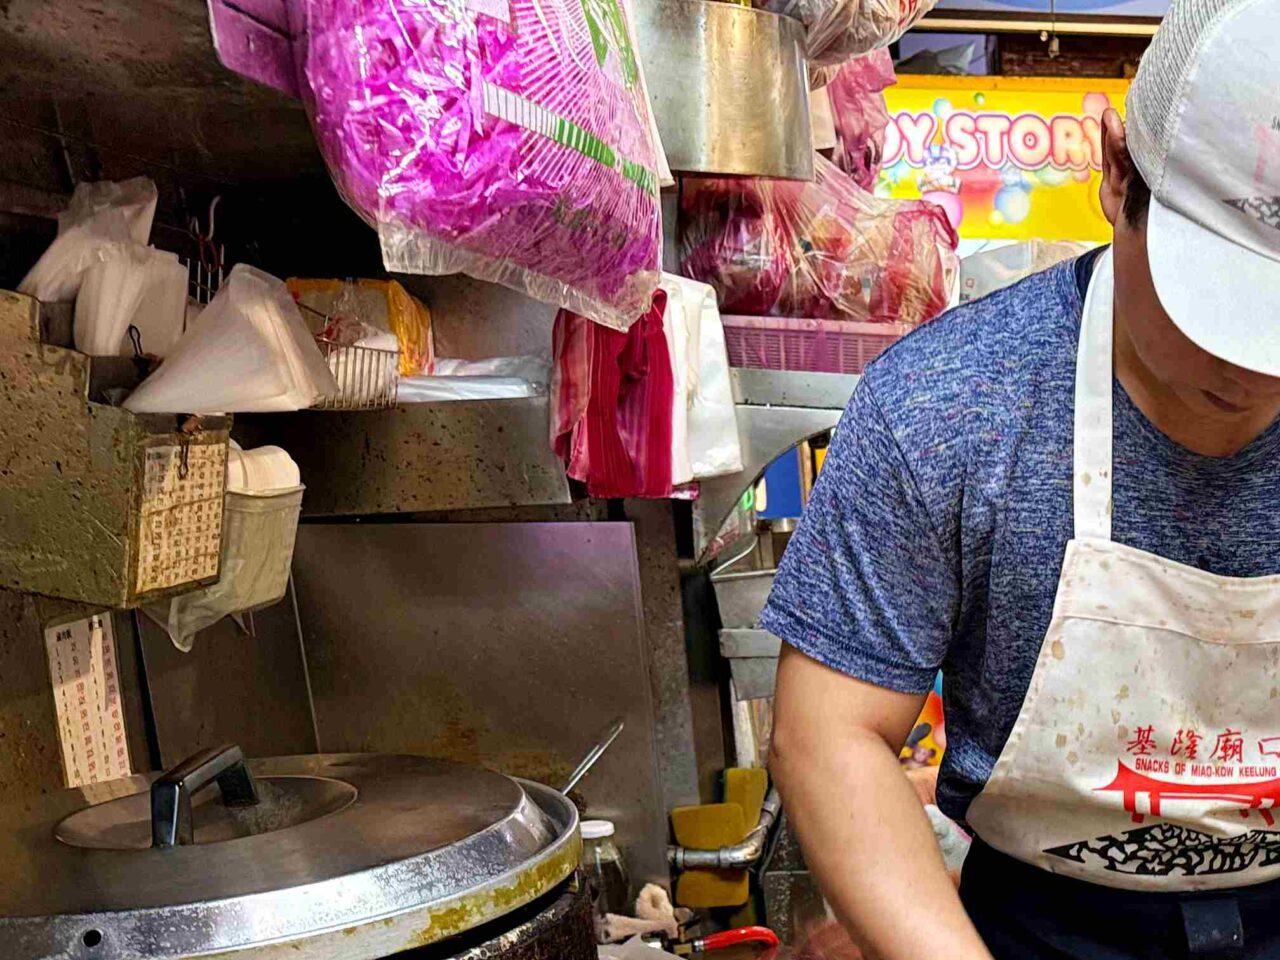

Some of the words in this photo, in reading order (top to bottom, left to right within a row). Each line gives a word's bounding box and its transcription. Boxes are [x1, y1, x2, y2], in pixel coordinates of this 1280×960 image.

[1135, 758, 1169, 773] SNACKS
[1175, 762, 1186, 775] OF
[1191, 764, 1234, 777] MIAO-KOW
[1239, 766, 1277, 777] KEELUNG
